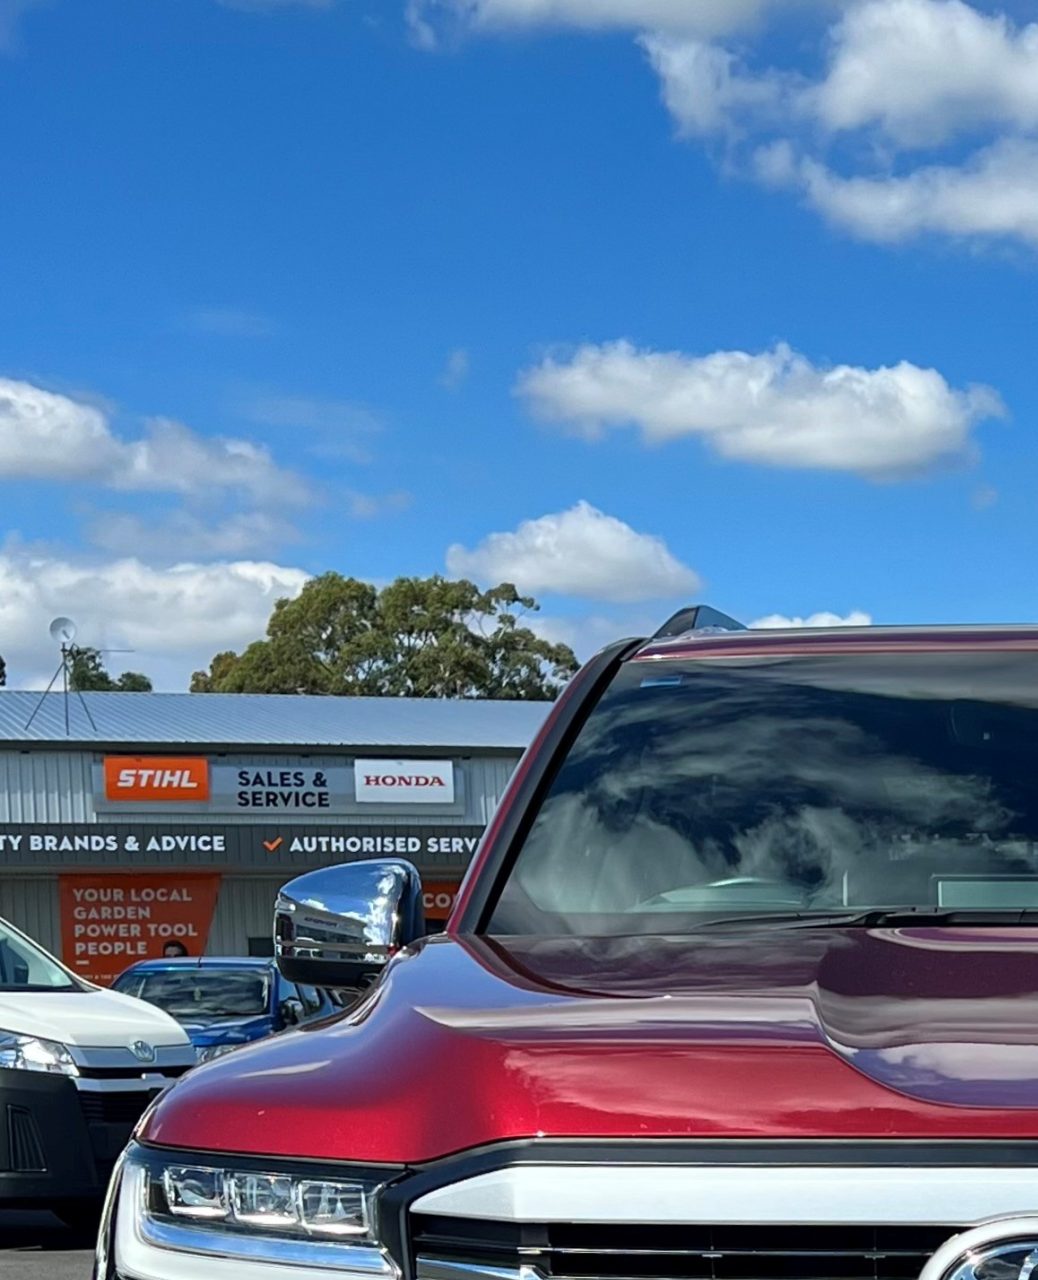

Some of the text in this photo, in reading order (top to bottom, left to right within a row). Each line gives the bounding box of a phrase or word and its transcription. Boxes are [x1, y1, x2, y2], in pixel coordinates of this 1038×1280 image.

[117, 769, 198, 788] STIHL
[238, 771, 328, 788] SALES &
[364, 775, 446, 787] HONDA
[237, 791, 330, 808] SERVICE
[29, 835, 118, 851] BRANDS
[124, 835, 140, 851] &
[146, 835, 225, 852] ADVICE
[289, 836, 482, 853] AUTHORISED SERV
[73, 888, 192, 902] YOUR LOCAL
[73, 906, 151, 920] GARDEN
[75, 923, 198, 938] POWER TOOL
[75, 941, 148, 956] PEOPLE
